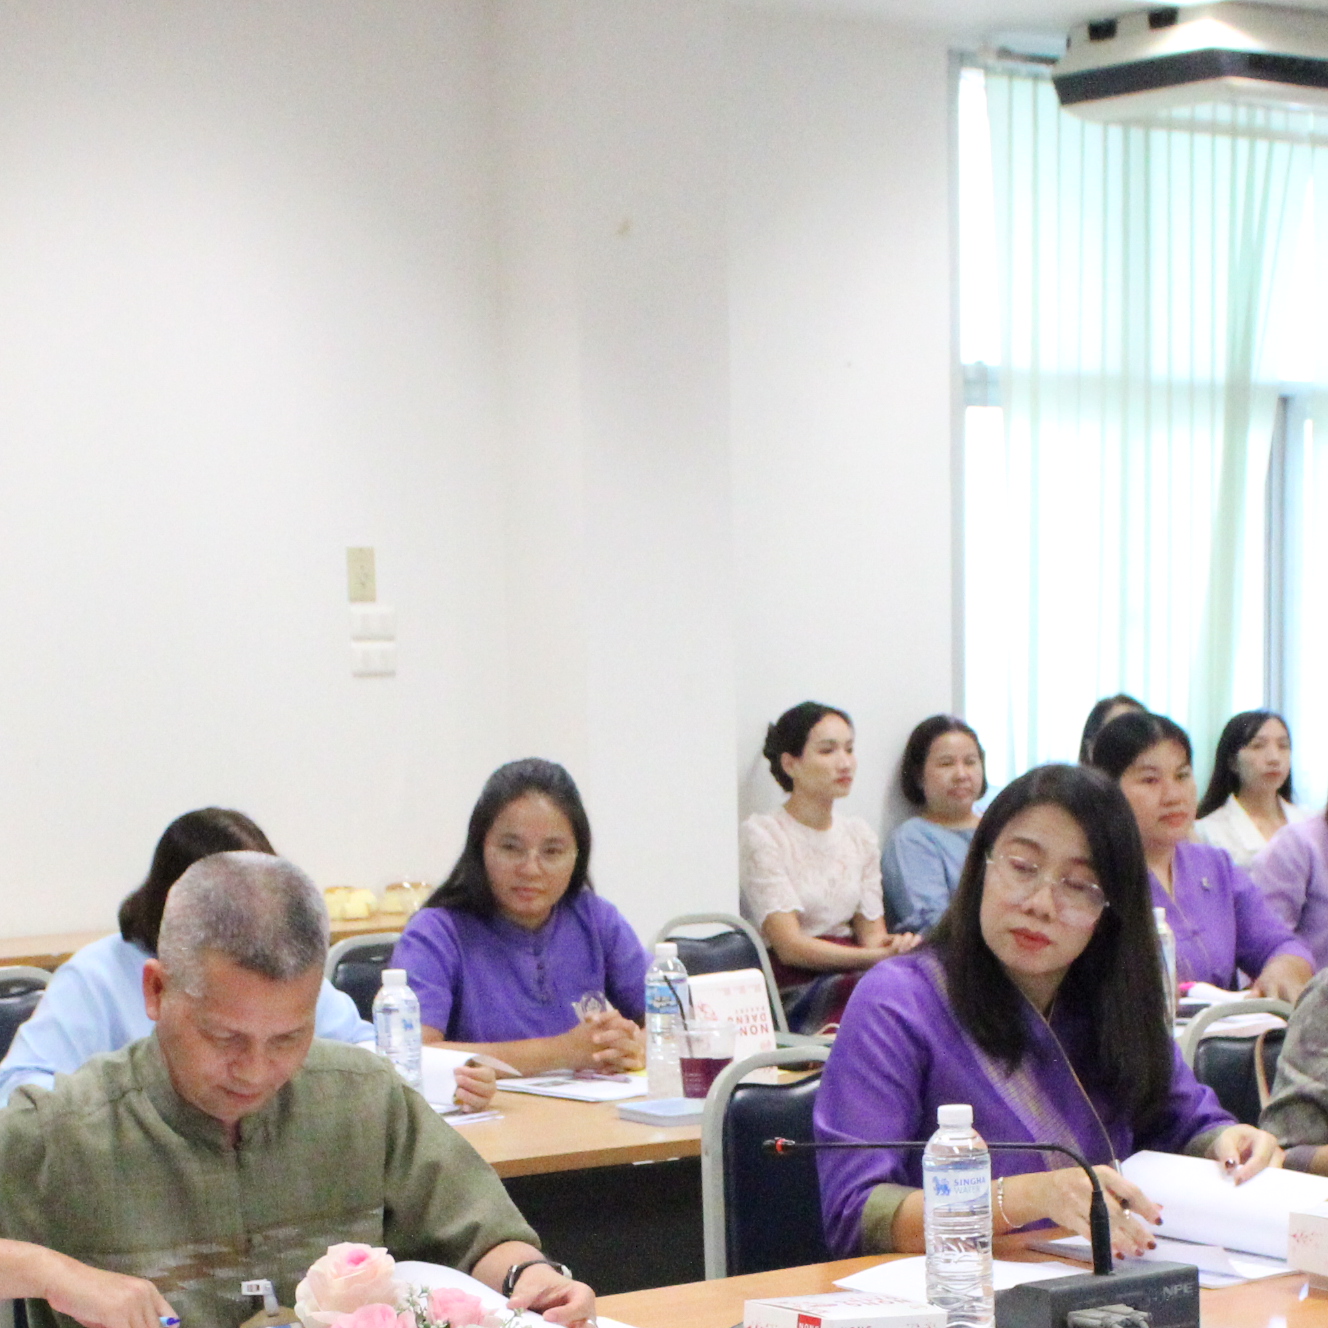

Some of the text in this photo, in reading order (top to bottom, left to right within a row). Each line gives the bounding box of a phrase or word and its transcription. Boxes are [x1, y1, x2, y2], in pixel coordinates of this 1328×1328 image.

[739, 1023, 769, 1036] NON
[954, 1177, 986, 1187] SINGHA
[1162, 1282, 1195, 1297] NPE
